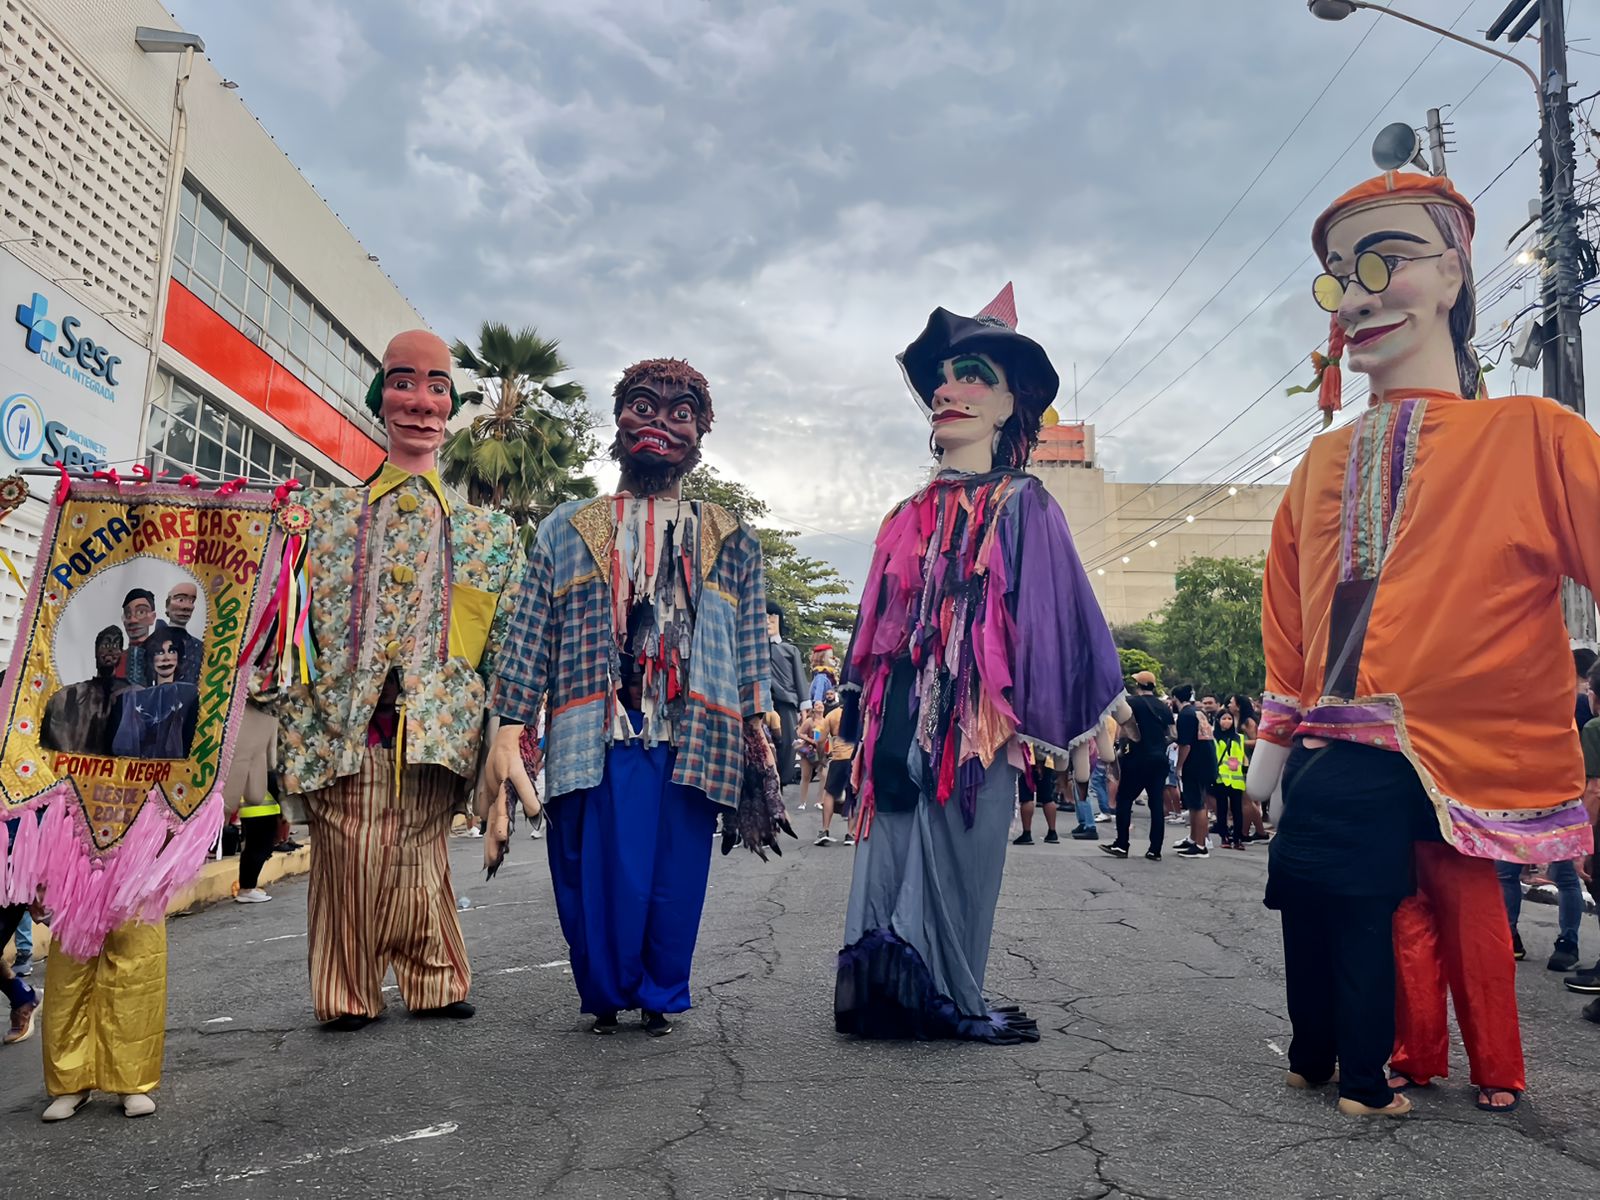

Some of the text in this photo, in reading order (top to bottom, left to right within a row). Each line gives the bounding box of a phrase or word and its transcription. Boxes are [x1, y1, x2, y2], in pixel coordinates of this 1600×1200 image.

[58, 315, 122, 386] Sesc
[72, 367, 115, 403] INTEGRADA
[178, 538, 258, 585] BRUXAS
[191, 582, 241, 788] LOBISOMENS
[54, 753, 171, 782] PONTA NEGRA
